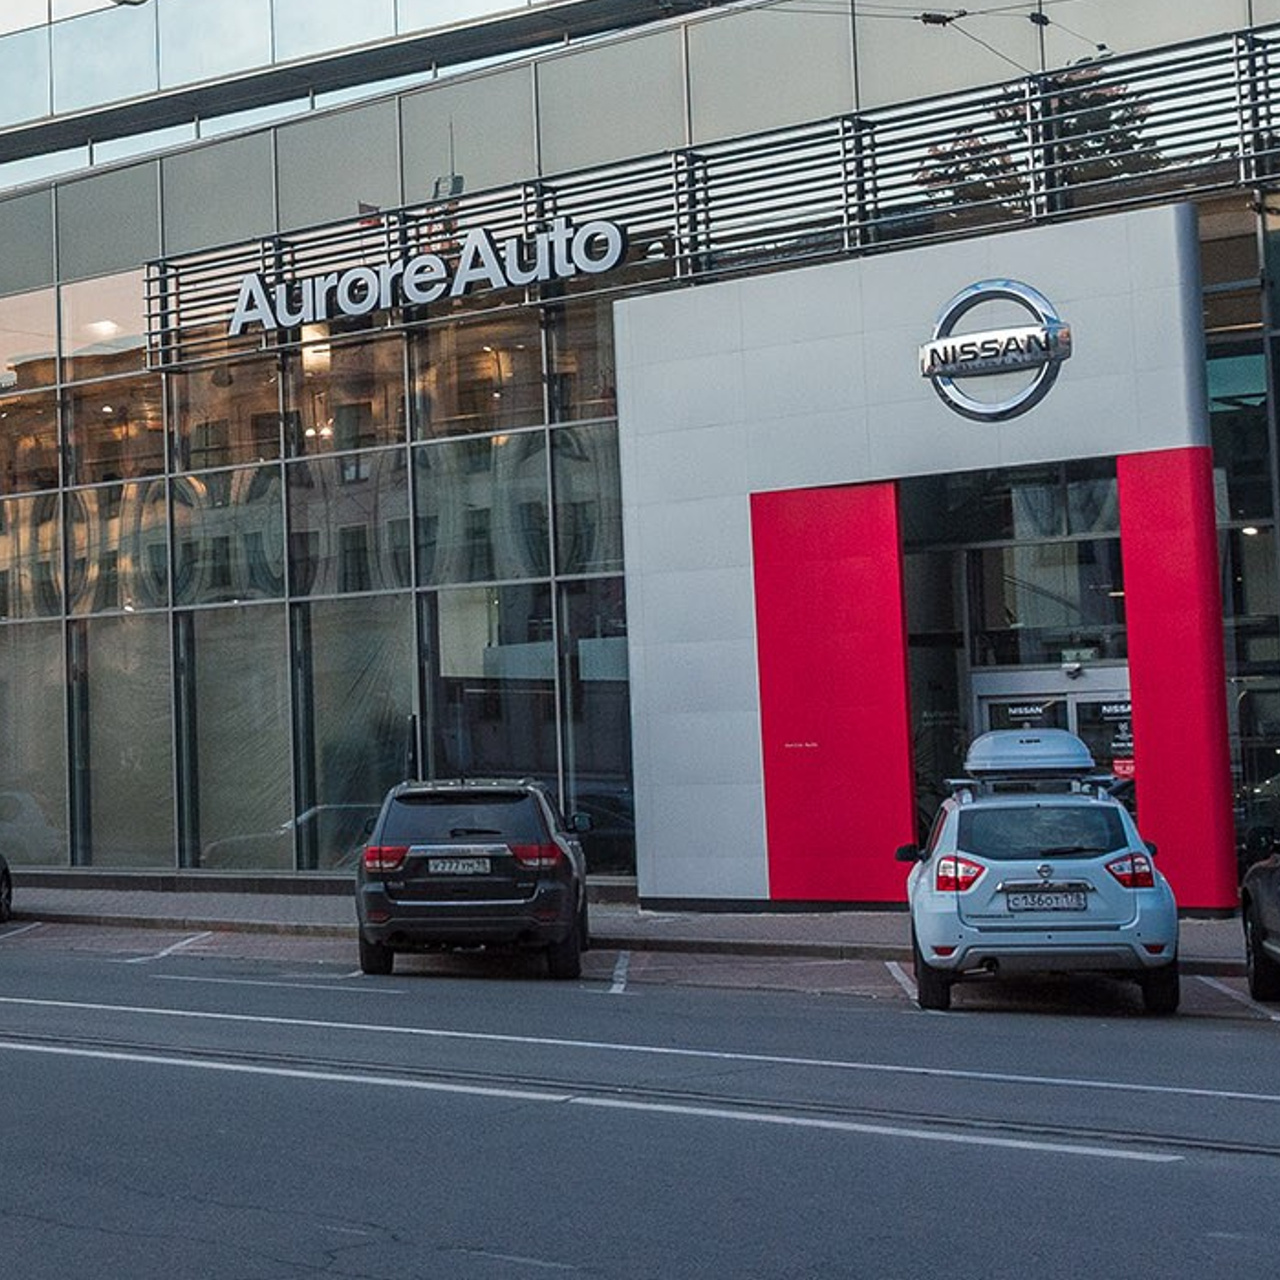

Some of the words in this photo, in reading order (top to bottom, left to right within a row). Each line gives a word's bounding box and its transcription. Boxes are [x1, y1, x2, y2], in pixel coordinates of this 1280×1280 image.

[228, 218, 627, 336] AuroreAuto
[930, 333, 1051, 366] NISSAN
[1008, 706, 1043, 715] NISSAN
[1101, 705, 1133, 715] NISSA
